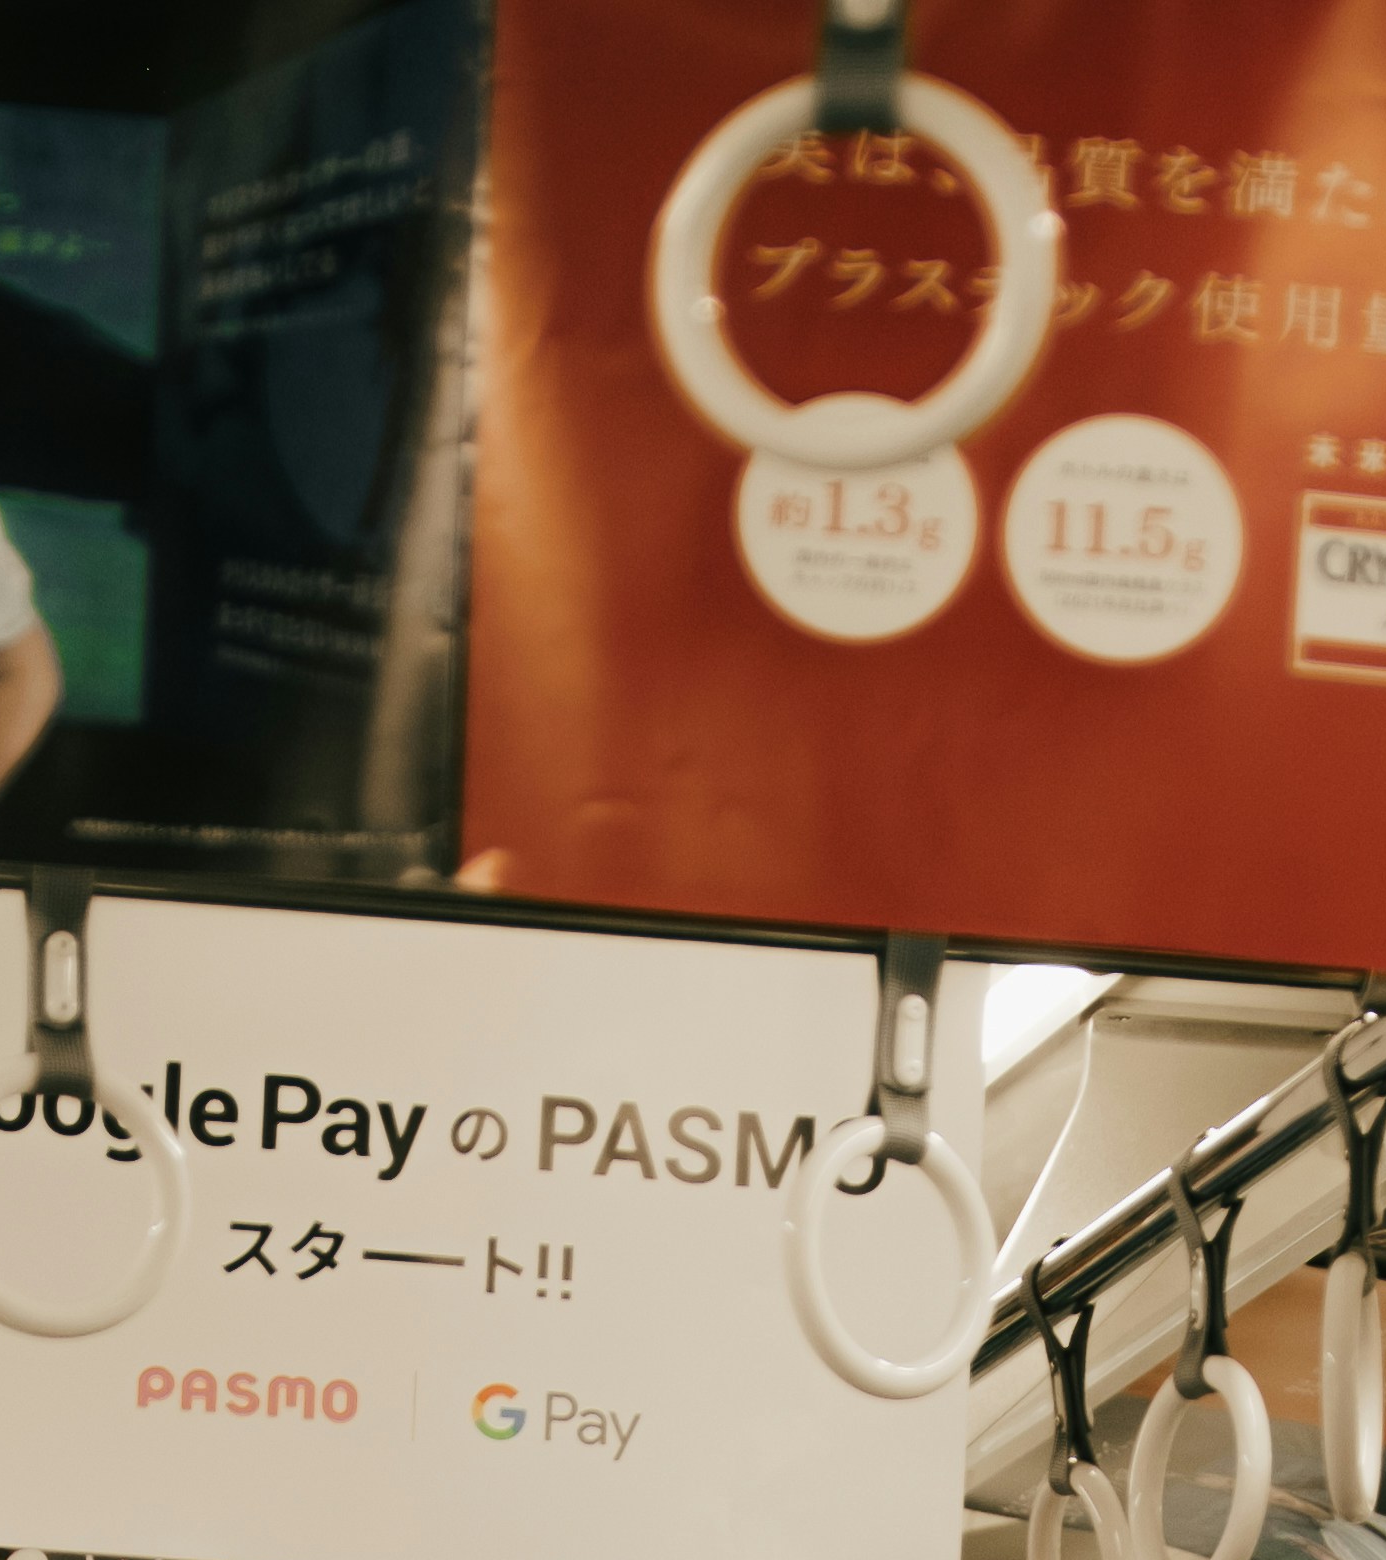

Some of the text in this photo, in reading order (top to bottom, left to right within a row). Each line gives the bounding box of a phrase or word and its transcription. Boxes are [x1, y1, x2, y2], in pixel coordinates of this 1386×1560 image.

[1045, 497, 1208, 574] 11.5g
[261, 1071, 427, 1182] Pay
[451, 1106, 508, 1162] の
[222, 1216, 576, 1303] スタート!!
[135, 1363, 360, 1425] PASMO
[542, 1392, 642, 1463] Pay
